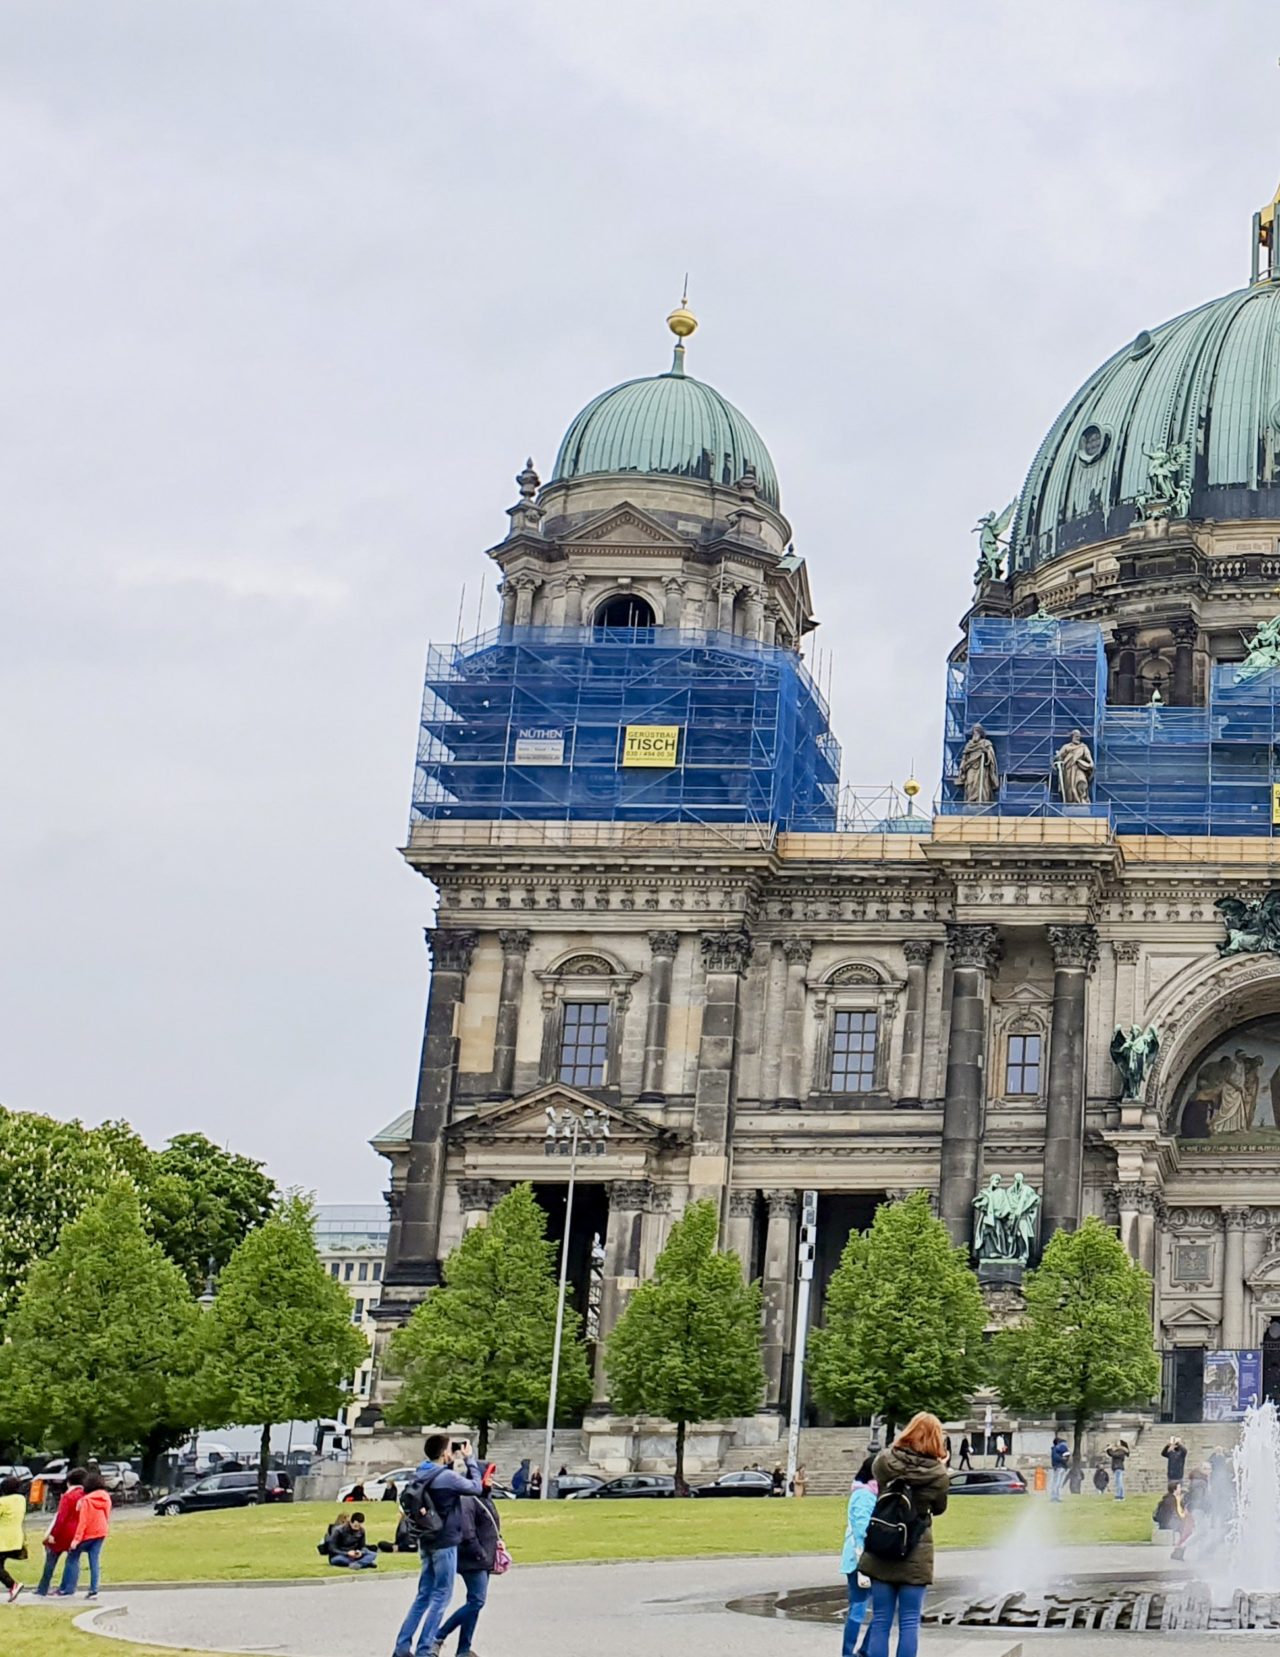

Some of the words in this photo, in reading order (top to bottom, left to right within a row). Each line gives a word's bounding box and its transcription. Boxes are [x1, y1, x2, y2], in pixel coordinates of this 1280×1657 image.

[519, 727, 563, 738] NÜTHEN
[628, 730, 676, 738] GERÜSTBAU
[628, 738, 675, 751] TISCH
